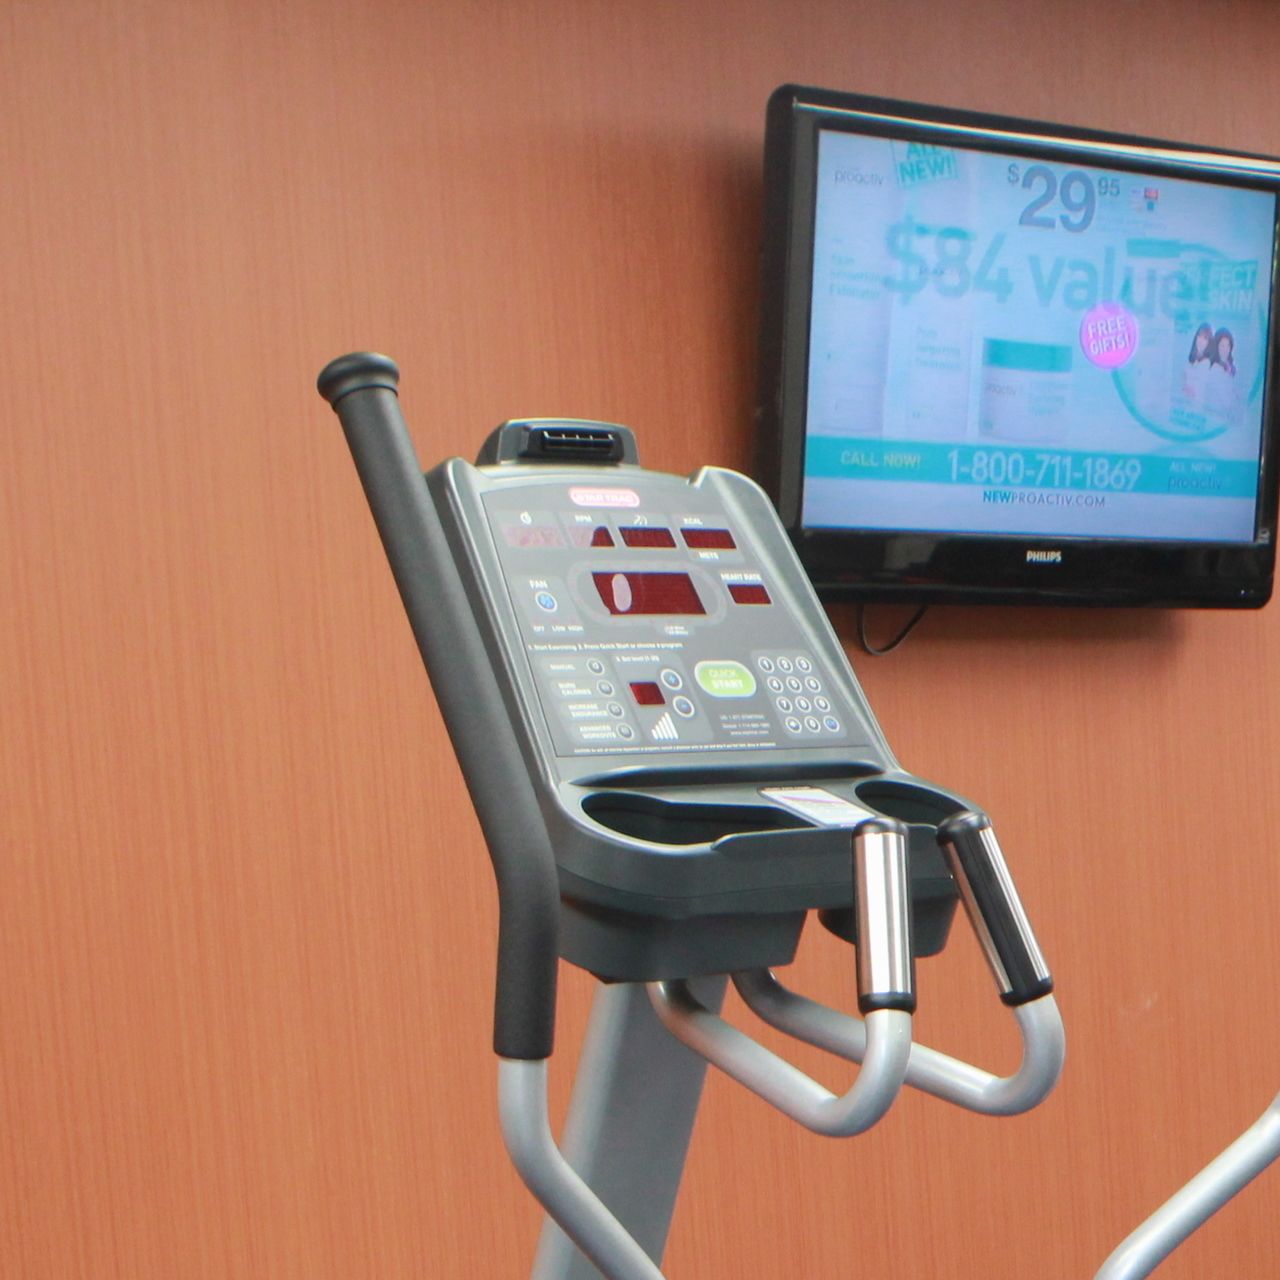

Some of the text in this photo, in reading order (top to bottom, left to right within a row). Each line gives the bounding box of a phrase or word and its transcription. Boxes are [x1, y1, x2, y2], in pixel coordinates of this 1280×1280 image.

[898, 155, 952, 183] NEW!
[1088, 316, 1127, 340] FREE
[1089, 334, 1130, 356] GIFTS!
[840, 449, 922, 471] CALL NOW!
[946, 447, 1143, 491] 1-800-711-1869
[982, 489, 1106, 508] NEWPROACTIV.COM
[1026, 549, 1062, 564] PHILIPS
[529, 579, 548, 589] FAN
[708, 668, 736, 678] QUICK
[712, 678, 744, 689] START
